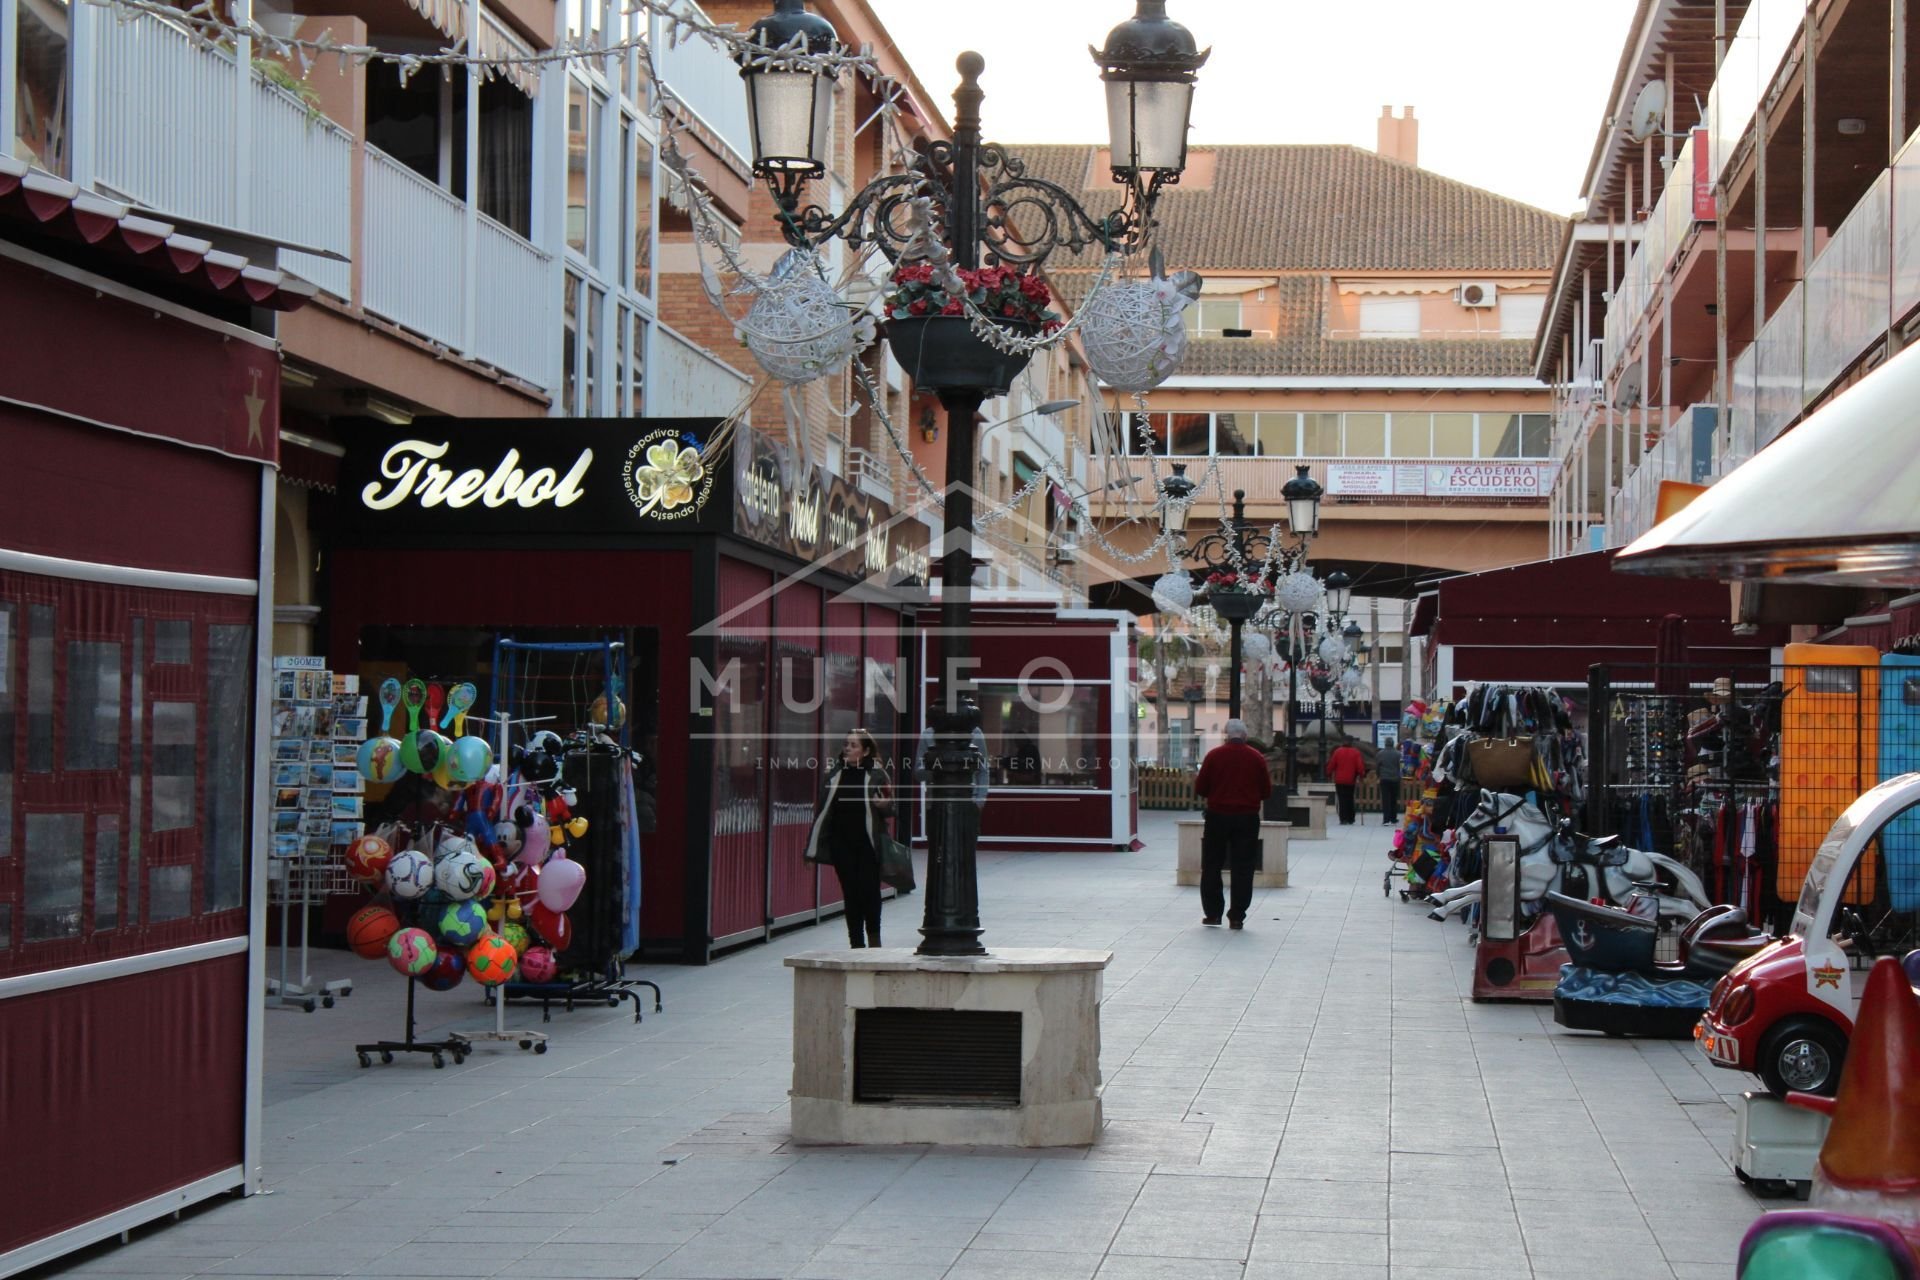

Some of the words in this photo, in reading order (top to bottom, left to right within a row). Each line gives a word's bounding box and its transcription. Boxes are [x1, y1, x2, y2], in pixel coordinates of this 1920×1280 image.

[628, 428, 681, 459] deportivas
[361, 439, 594, 511] Trebol
[621, 459, 643, 509] apuestas
[1449, 475, 1536, 487] ESCUDERO
[1453, 466, 1532, 476] ACADEMIA
[695, 479, 713, 508] mejor
[650, 504, 696, 521] apuesta
